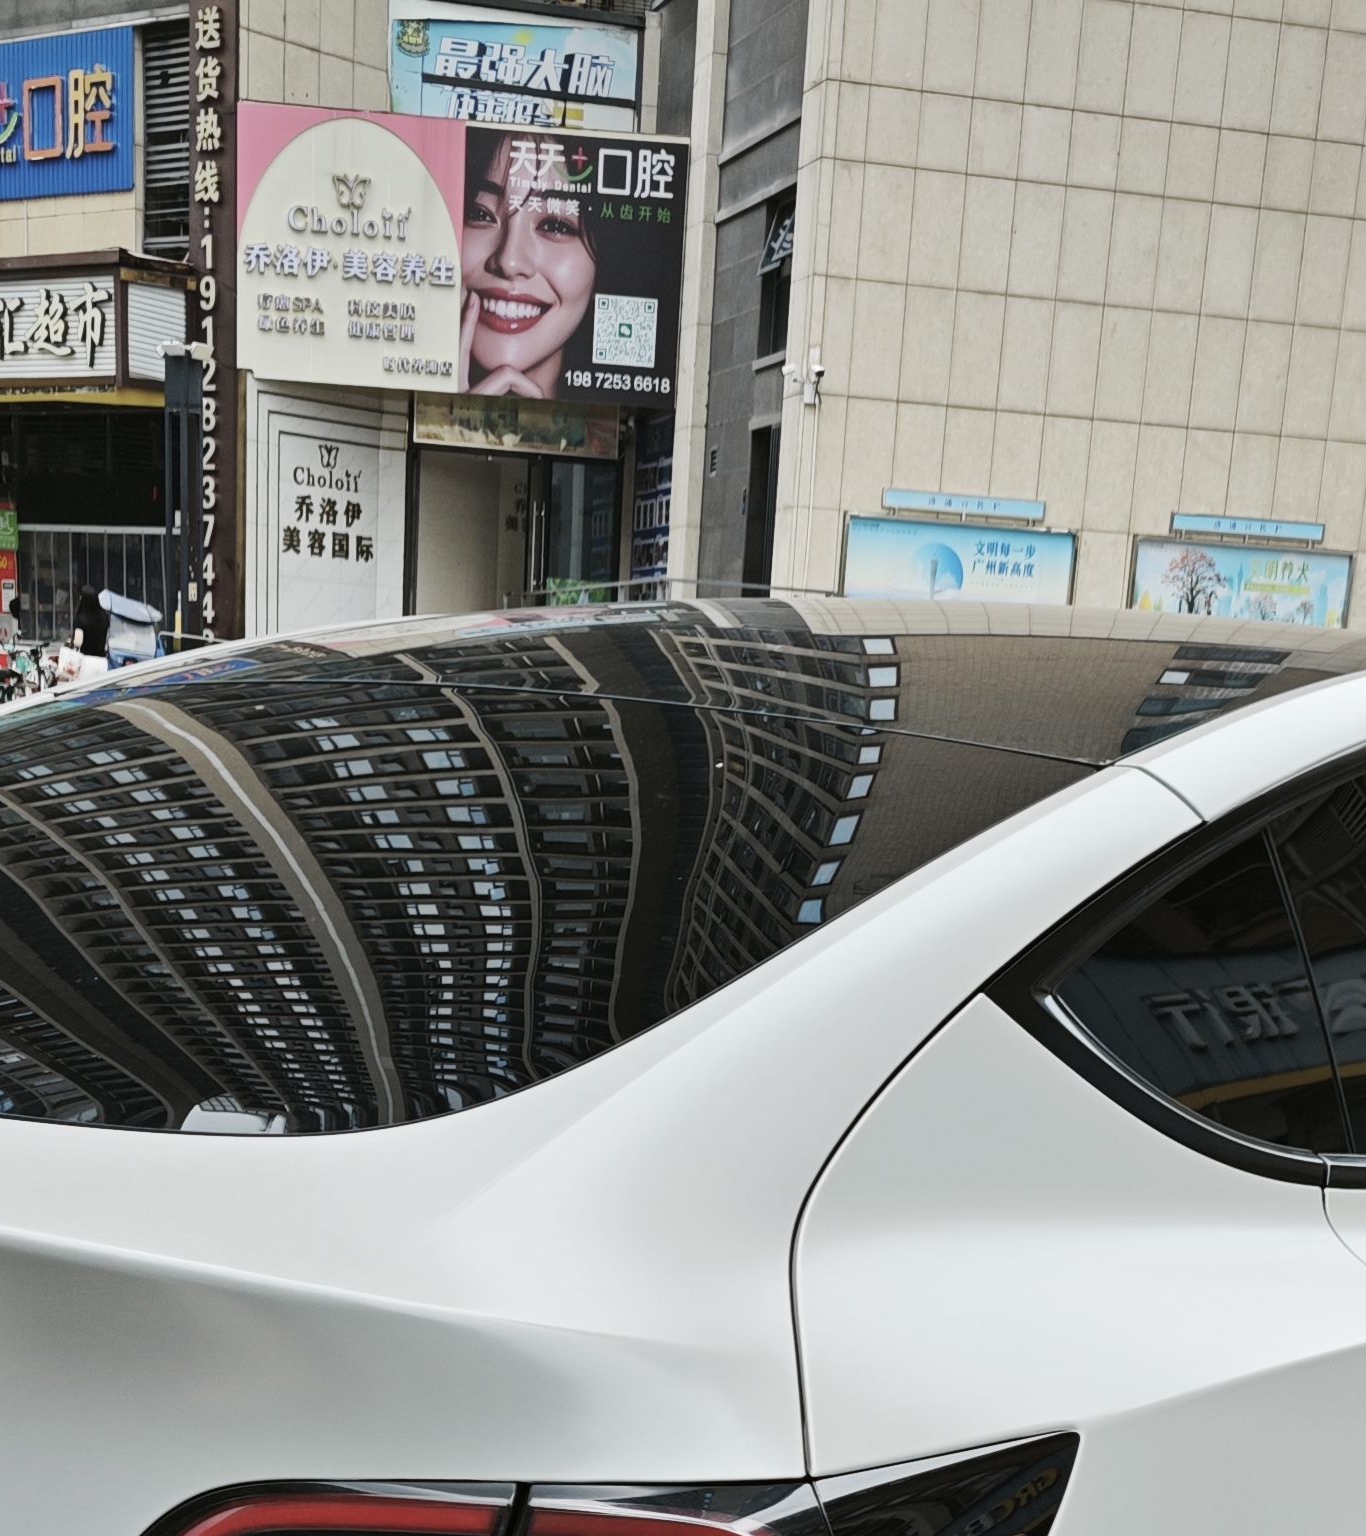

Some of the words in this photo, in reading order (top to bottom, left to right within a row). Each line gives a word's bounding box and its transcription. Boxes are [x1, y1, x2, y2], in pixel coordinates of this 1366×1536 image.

[435, 37, 616, 98] 最强大脑
[509, 176, 547, 191] Timely
[554, 179, 592, 194] Dental
[564, 369, 591, 389] 198
[594, 373, 631, 392] 7253
[633, 375, 671, 395] 6618
[293, 494, 363, 526] 乔洛伊
[282, 525, 375, 564] 美容国际
[975, 541, 1036, 558] 文明每一步
[972, 559, 1035, 578] 广州新高度
